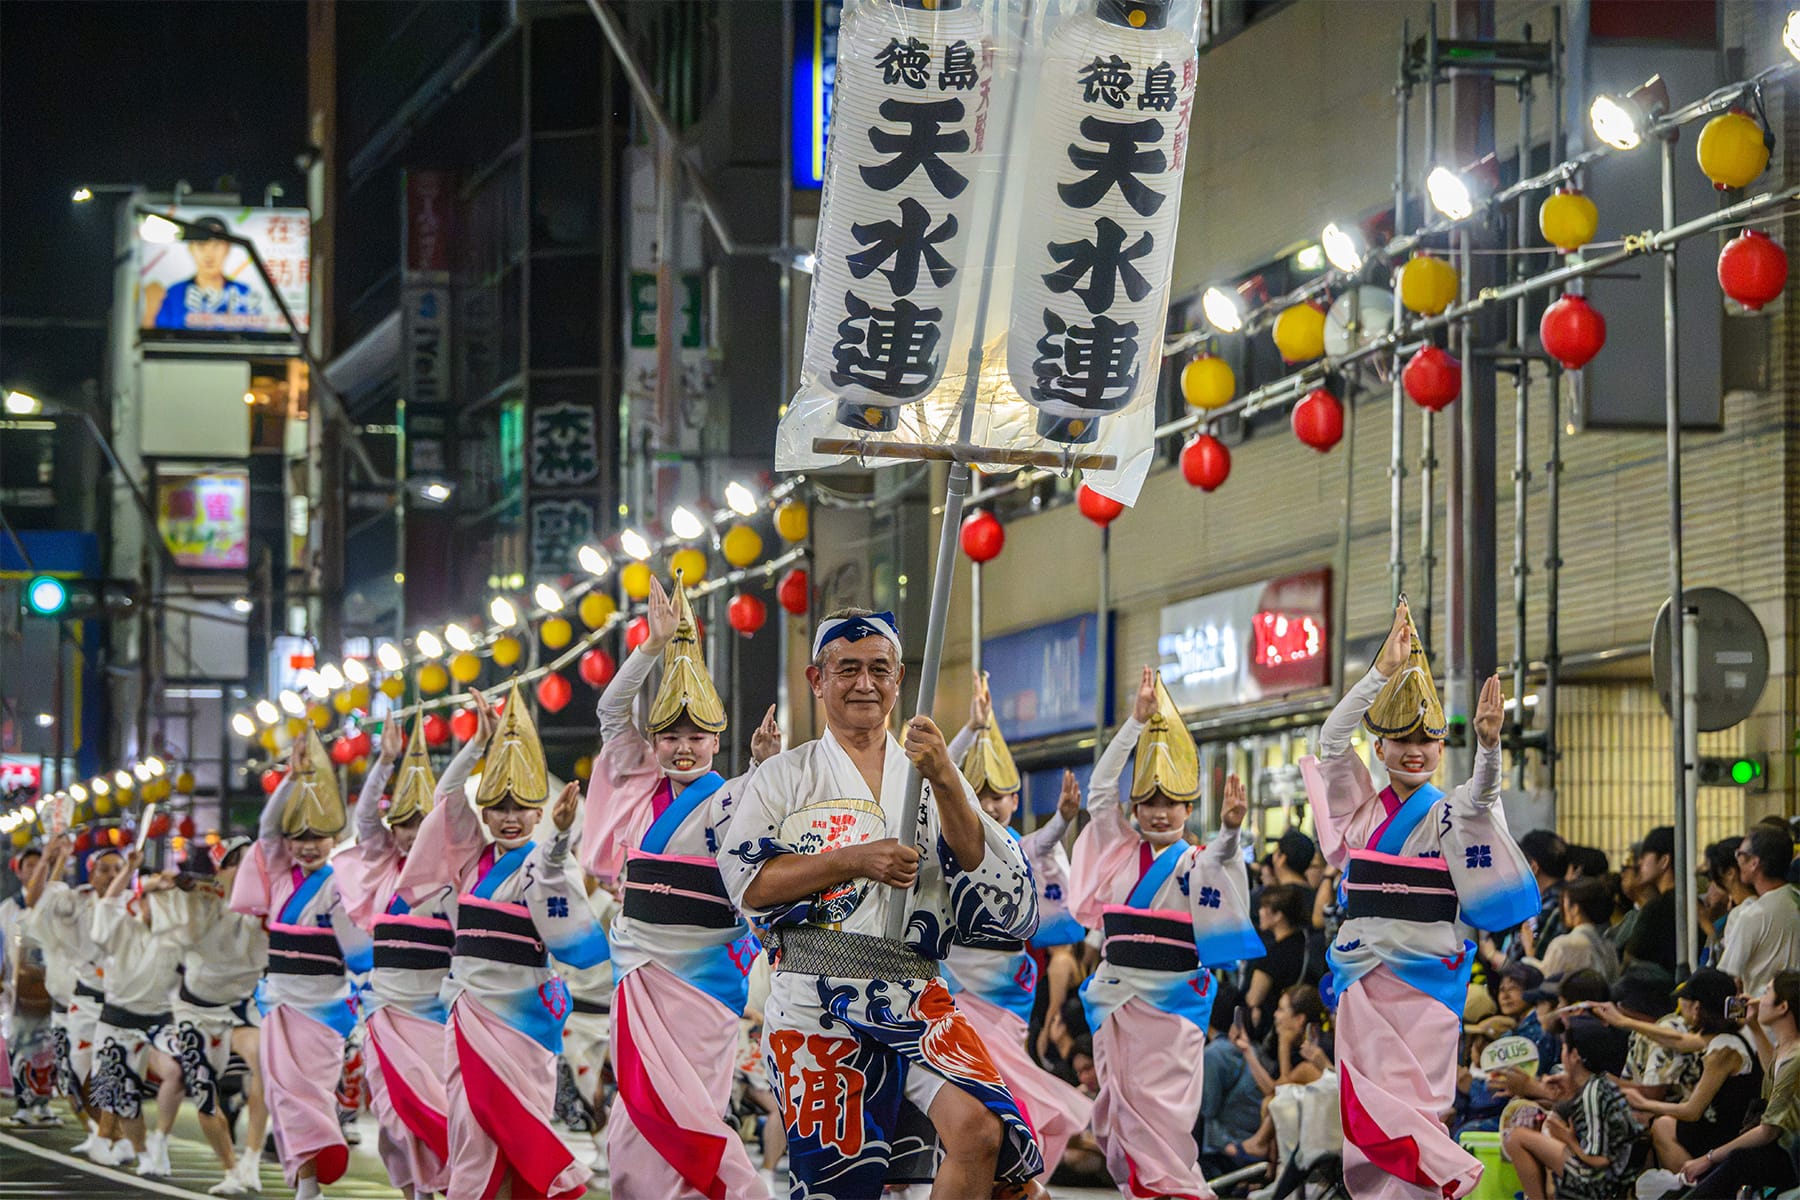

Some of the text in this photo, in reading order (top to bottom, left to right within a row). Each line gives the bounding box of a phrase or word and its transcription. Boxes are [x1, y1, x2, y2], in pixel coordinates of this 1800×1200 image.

[874, 36, 979, 91] 徳島
[1078, 54, 1178, 111] 徳島
[830, 97, 971, 398] 天水連
[1031, 115, 1168, 411] 天水連
[768, 1029, 866, 1157] 踊
[1487, 1042, 1529, 1062] POLUS
